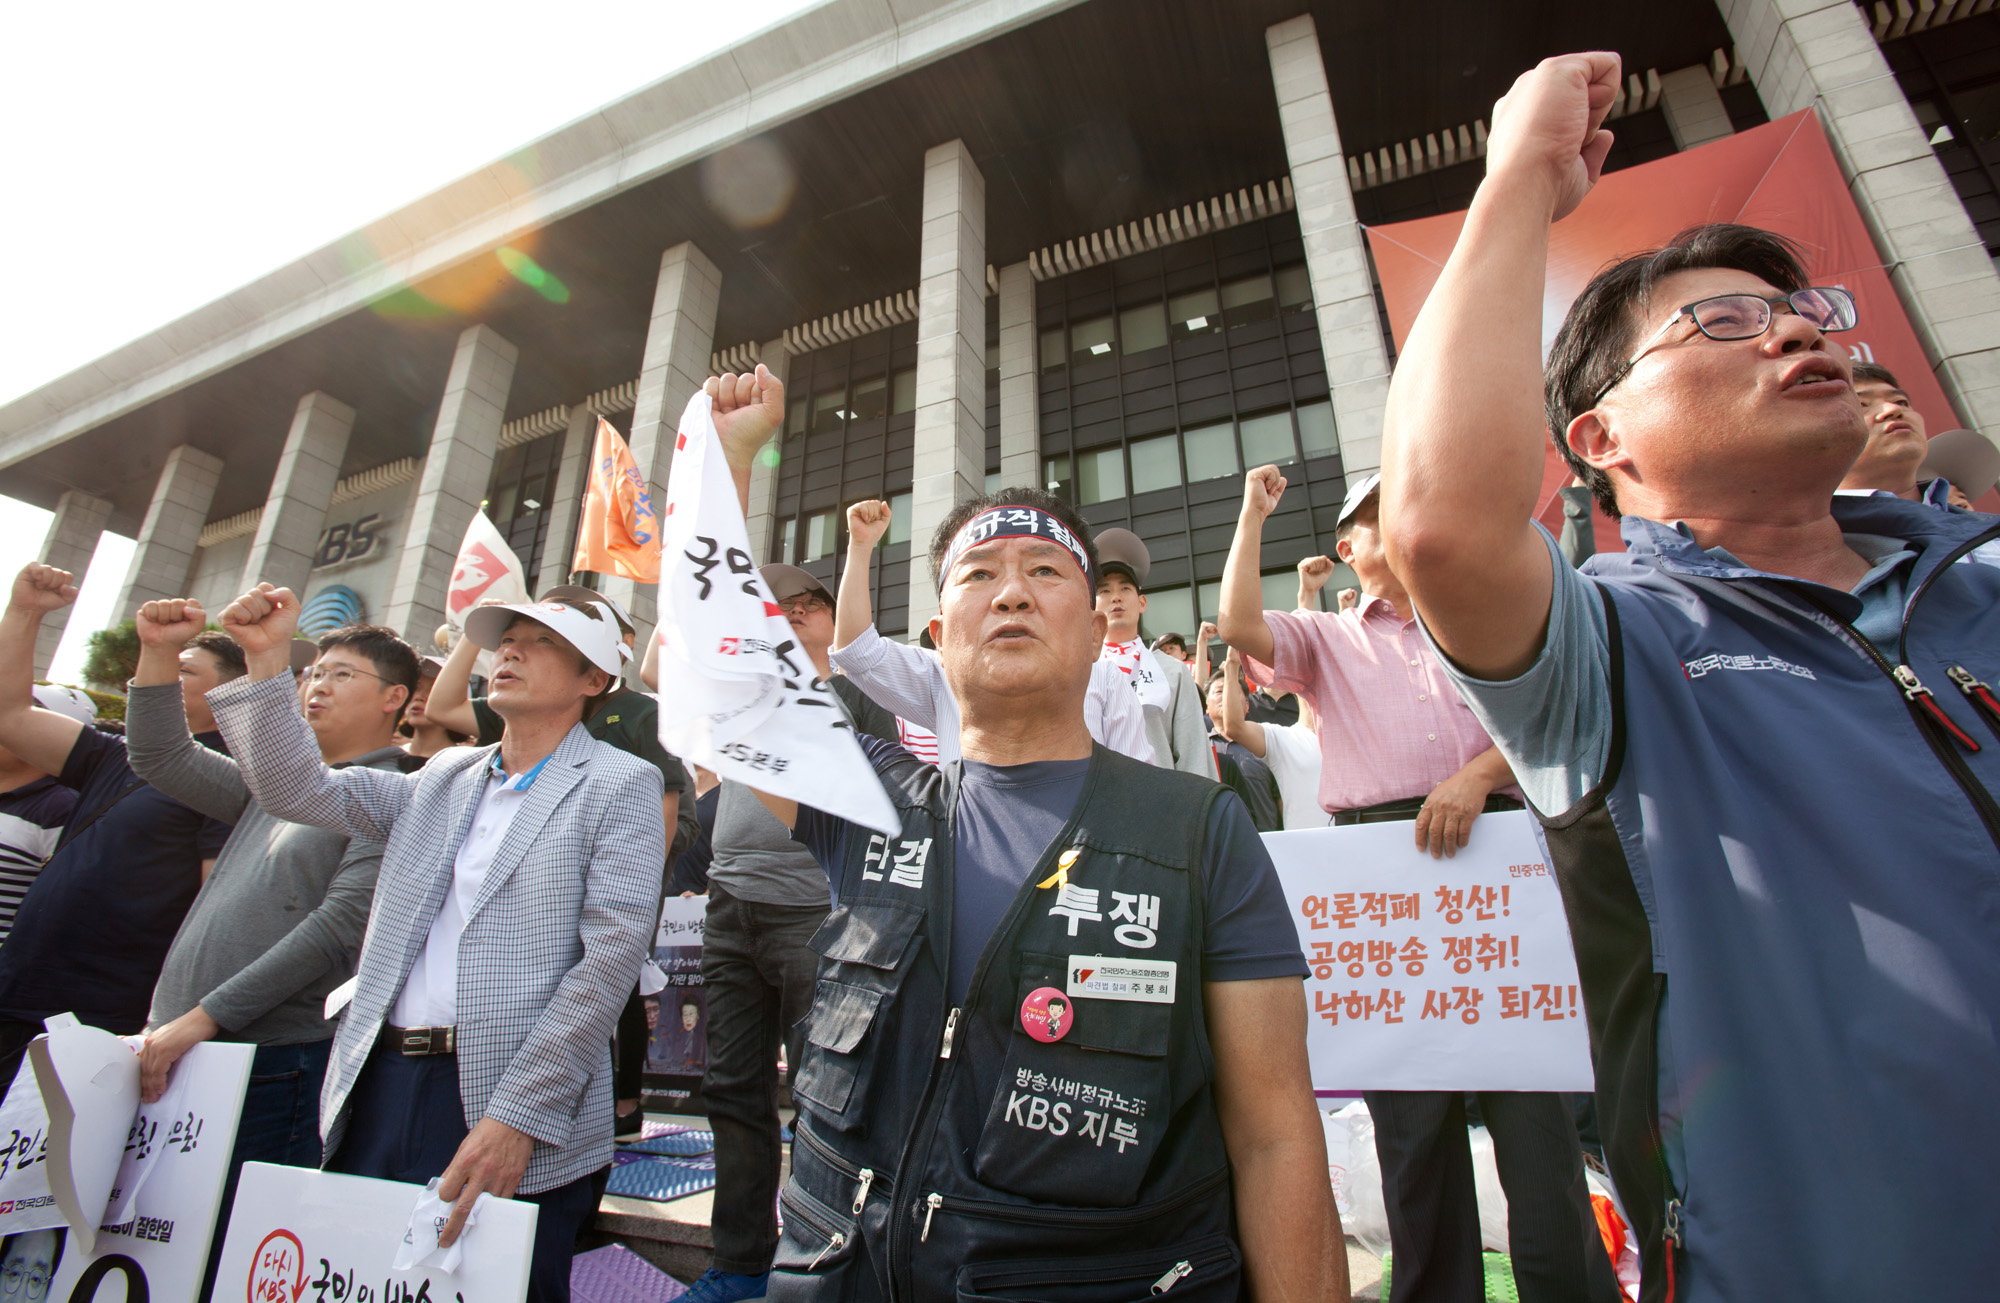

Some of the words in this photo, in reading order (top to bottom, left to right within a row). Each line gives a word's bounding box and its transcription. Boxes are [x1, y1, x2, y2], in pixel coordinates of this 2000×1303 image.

[1046, 517, 1089, 573] 철폐
[862, 833, 933, 889] 단결
[1508, 863, 1552, 878] 민중연
[1048, 882, 1162, 949] 투쟁
[1301, 891, 1421, 930] 언론적폐
[1434, 885, 1511, 925] 청산!
[1308, 936, 1429, 981] 공영방송
[1441, 933, 1520, 975] 쟁취!
[1314, 988, 1406, 1026] 낙하산
[1420, 986, 1484, 1025] 사장
[1497, 983, 1578, 1022] 퇴진!
[1004, 1091, 1072, 1137] KBS
[1077, 1111, 1140, 1154] 지부
[135, 1216, 175, 1243] 잘한일
[263, 1249, 292, 1277] 다시
[256, 1276, 287, 1303] KBS
